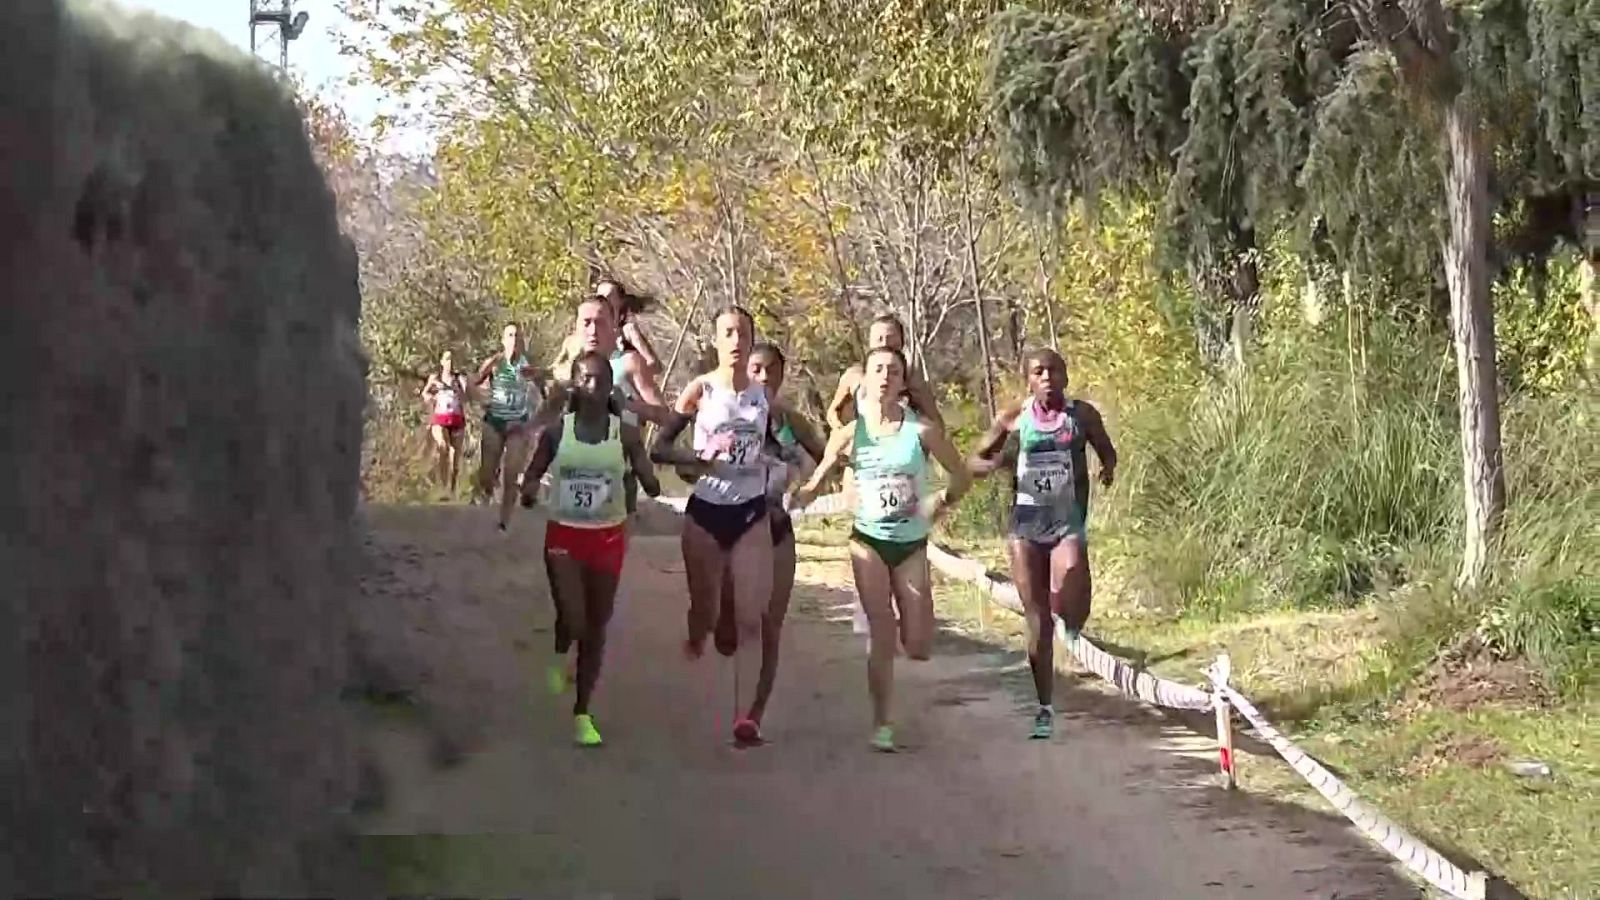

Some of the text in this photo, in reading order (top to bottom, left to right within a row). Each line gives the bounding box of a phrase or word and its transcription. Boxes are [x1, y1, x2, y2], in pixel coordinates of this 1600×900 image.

[1034, 478, 1052, 493] 54
[574, 491, 593, 507] 53
[880, 492, 898, 508] 56
